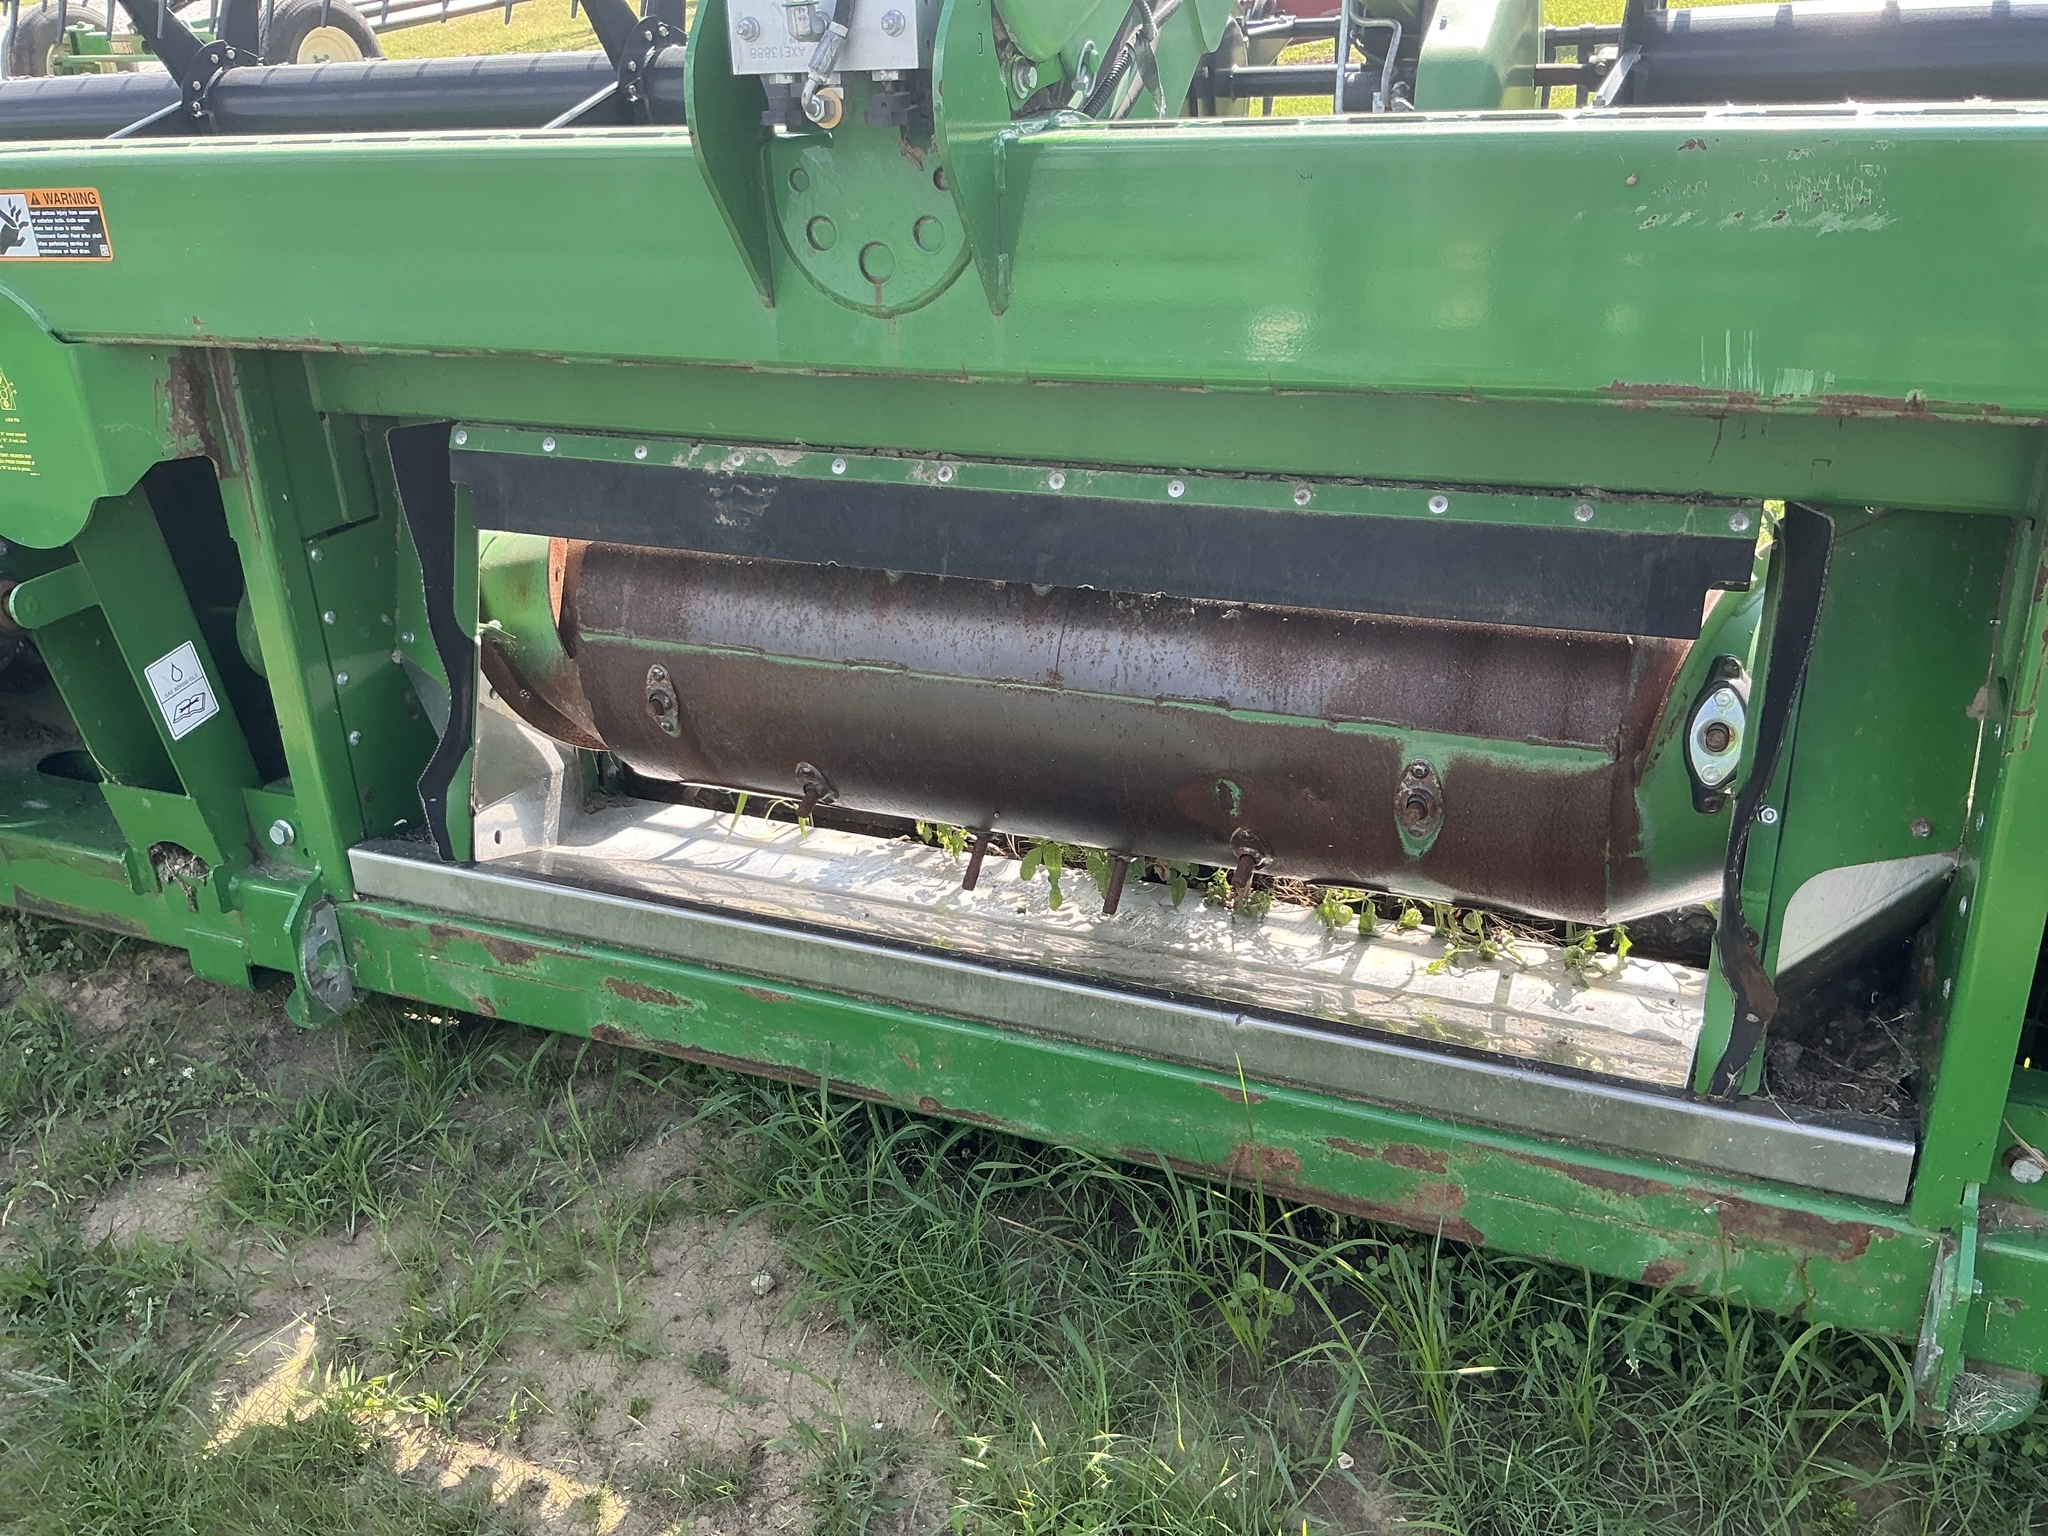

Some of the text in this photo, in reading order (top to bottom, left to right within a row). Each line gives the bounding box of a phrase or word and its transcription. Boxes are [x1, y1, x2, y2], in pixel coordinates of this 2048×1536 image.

[750, 46, 805, 59] AXE13888
[43, 192, 96, 204] WARNING
[164, 689, 174, 698] SAE
